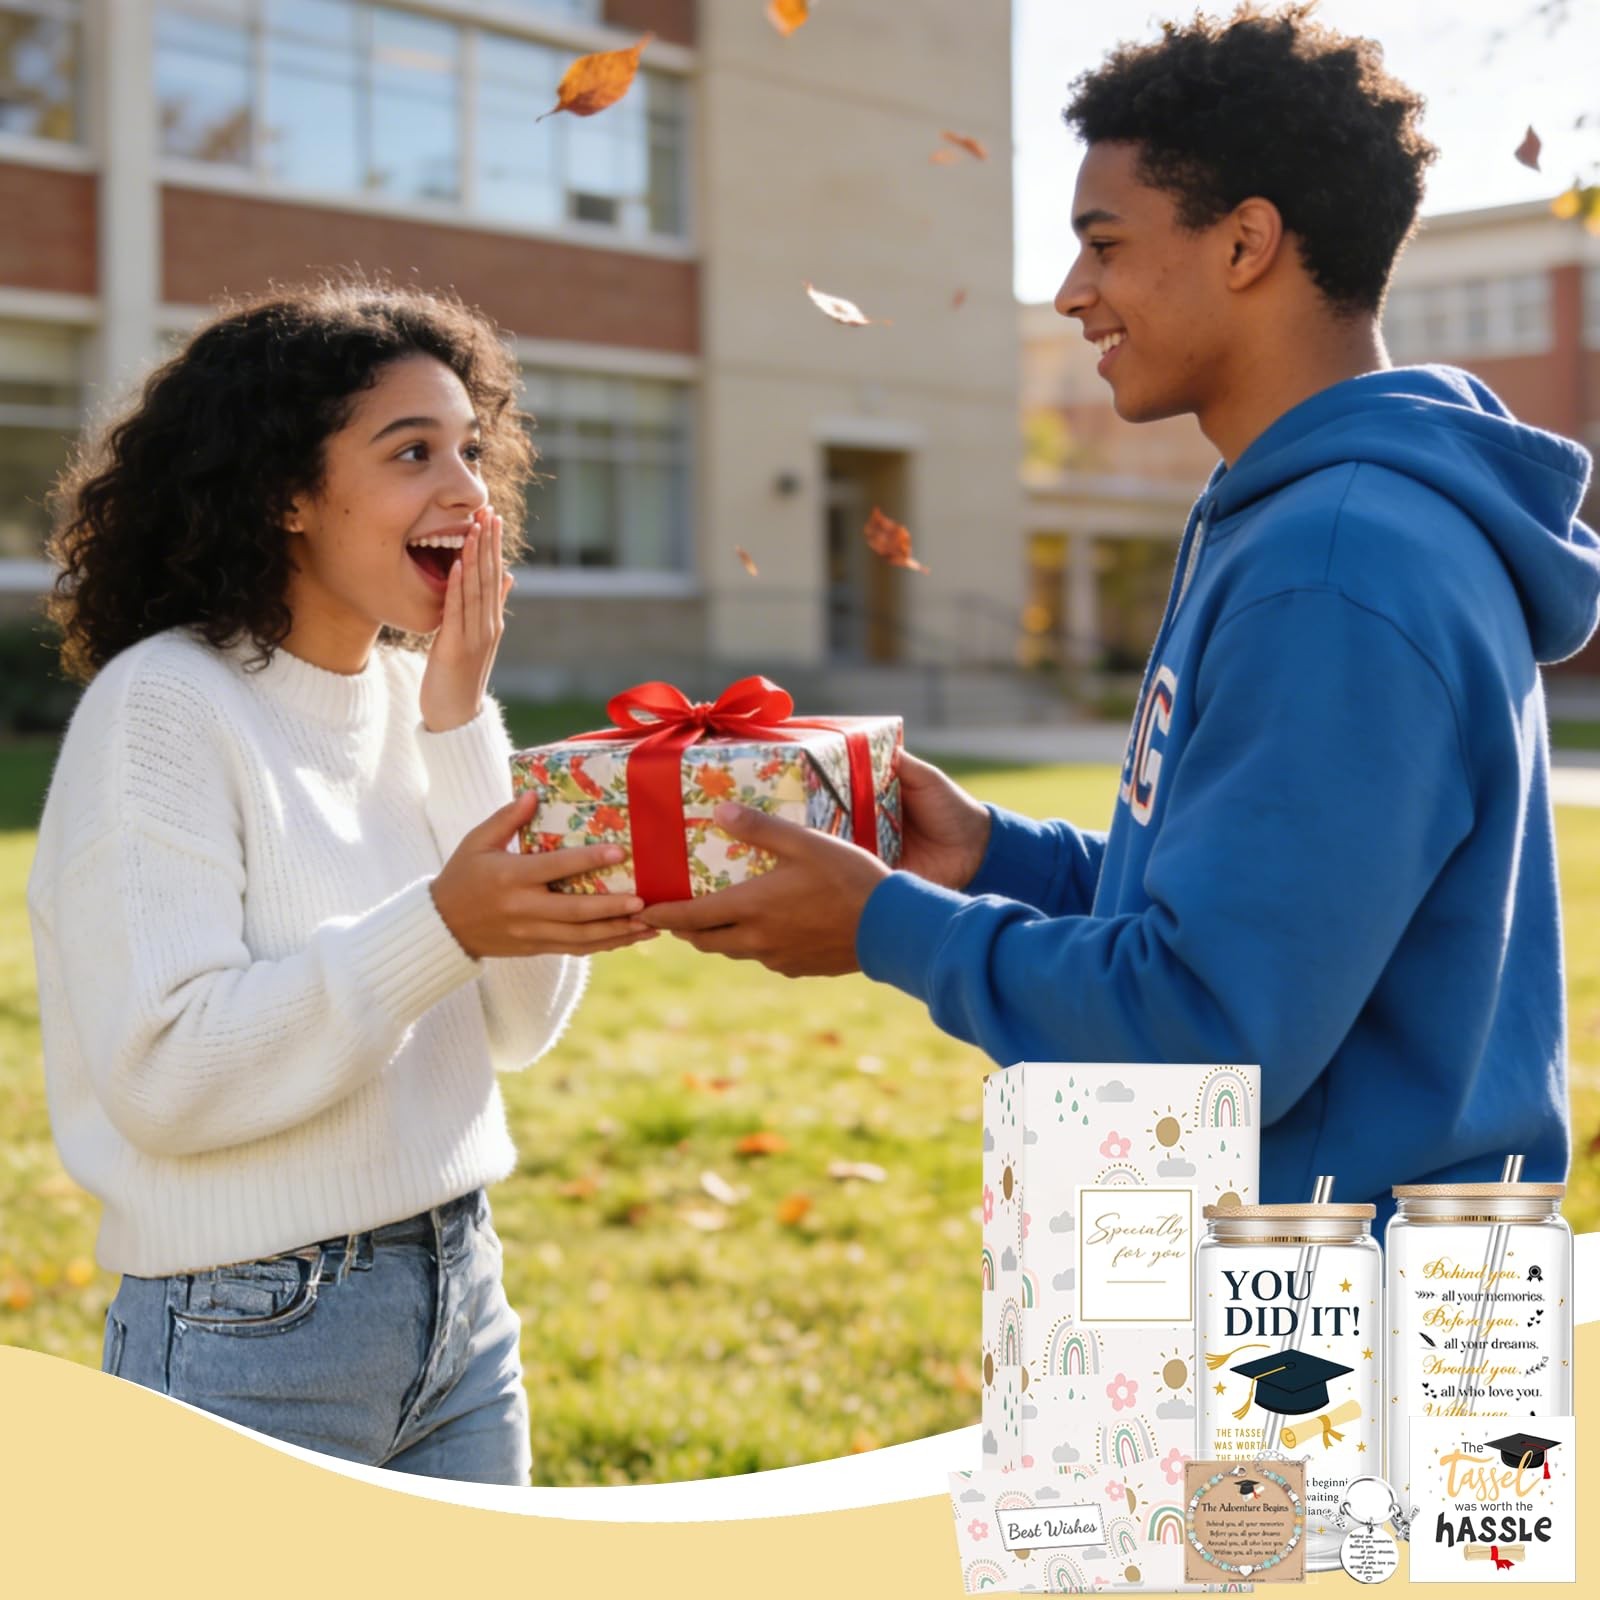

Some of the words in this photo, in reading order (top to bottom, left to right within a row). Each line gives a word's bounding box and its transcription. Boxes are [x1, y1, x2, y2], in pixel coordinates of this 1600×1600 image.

[1086, 1212, 1188, 1245] Specially
[1112, 1246, 1146, 1268] for
[1147, 1249, 1186, 1268] you
[1423, 1256, 1488, 1279] Behind
[1483, 1267, 1521, 1290] you.
[1221, 1270, 1313, 1301] YOU
[1441, 1290, 1455, 1302] all
[1458, 1292, 1487, 1306] your
[1486, 1291, 1546, 1302] memories.
[1224, 1306, 1298, 1336] DID
[1311, 1306, 1360, 1336] IT!
[1423, 1304, 1482, 1333] Before
[1480, 1317, 1519, 1338] you.
[1444, 1338, 1458, 1349] all
[1460, 1340, 1488, 1353] your
[1491, 1338, 1539, 1349] dreams.
[1423, 1354, 1489, 1375] Around
[1484, 1365, 1523, 1385] you.
[1440, 1385, 1455, 1397] all
[1458, 1385, 1485, 1397] who
[1489, 1385, 1514, 1397] love
[1516, 1389, 1543, 1401] you.
[1215, 1428, 1232, 1438] THE
[1215, 1441, 1233, 1450] WAS
[1236, 1441, 1267, 1450] WORTH
[1461, 1441, 1484, 1453] The
[1439, 1448, 1541, 1501] Tassel
[1201, 1502, 1217, 1512] The
[1219, 1502, 1261, 1512] Adventure
[1262, 1503, 1289, 1514] Begins
[1455, 1502, 1478, 1511] was
[1481, 1501, 1512, 1511] worth
[1515, 1501, 1534, 1511] the
[1008, 1522, 1042, 1540] Best
[1044, 1518, 1098, 1537] Wishes
